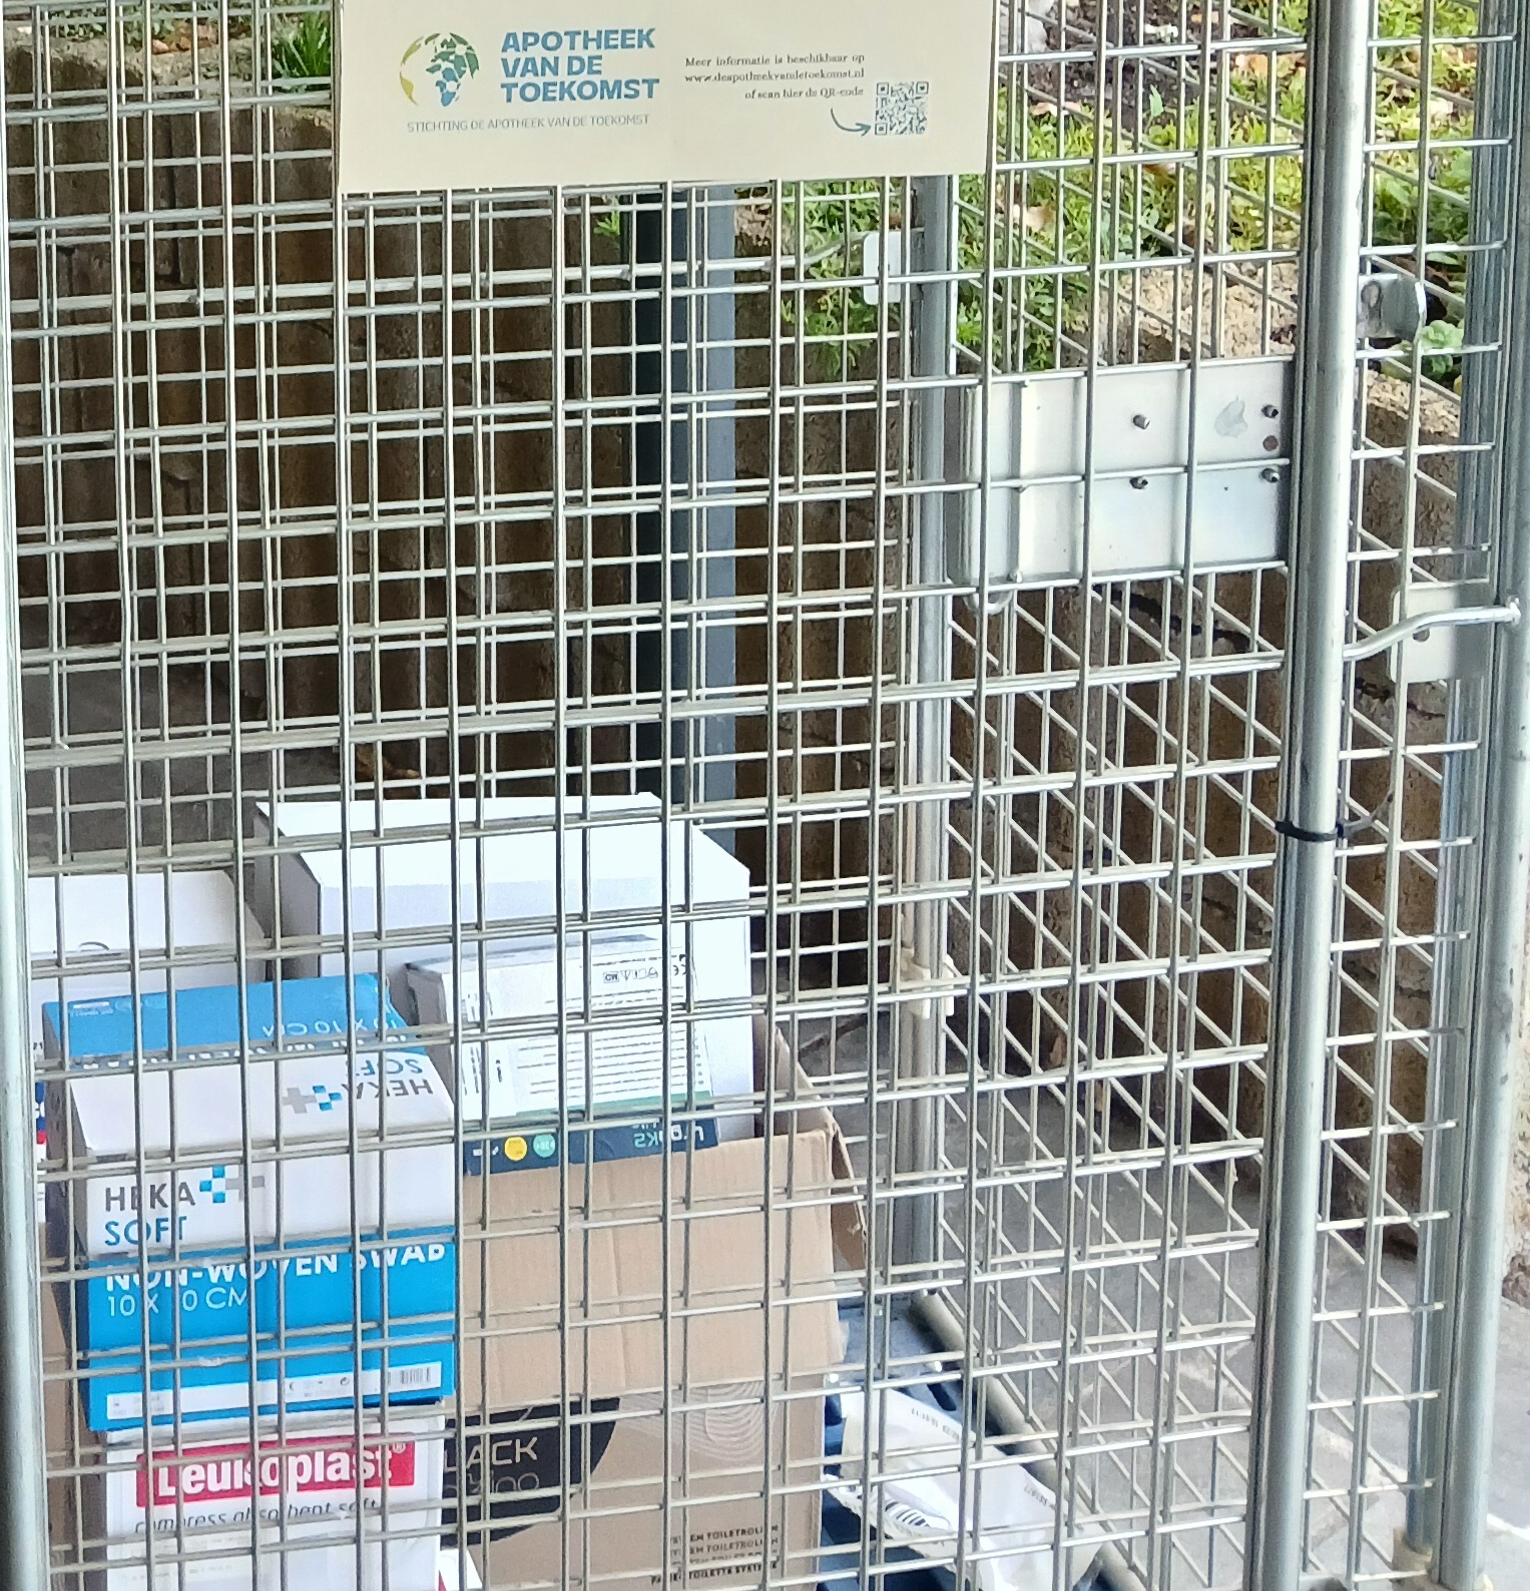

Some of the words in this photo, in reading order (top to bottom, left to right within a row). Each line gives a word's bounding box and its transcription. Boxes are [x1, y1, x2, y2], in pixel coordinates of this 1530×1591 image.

[501, 28, 656, 53] APOTHEEK
[500, 55, 559, 78] VAN
[566, 55, 603, 76] DE
[716, 54, 770, 66] informatie
[500, 78, 660, 103] TOEKOMST
[407, 119, 468, 133] STICHTING
[487, 117, 545, 130] APOTHEEK
[548, 116, 570, 128] VAN
[573, 115, 588, 127] DE
[590, 114, 650, 127] TOEKOMST
